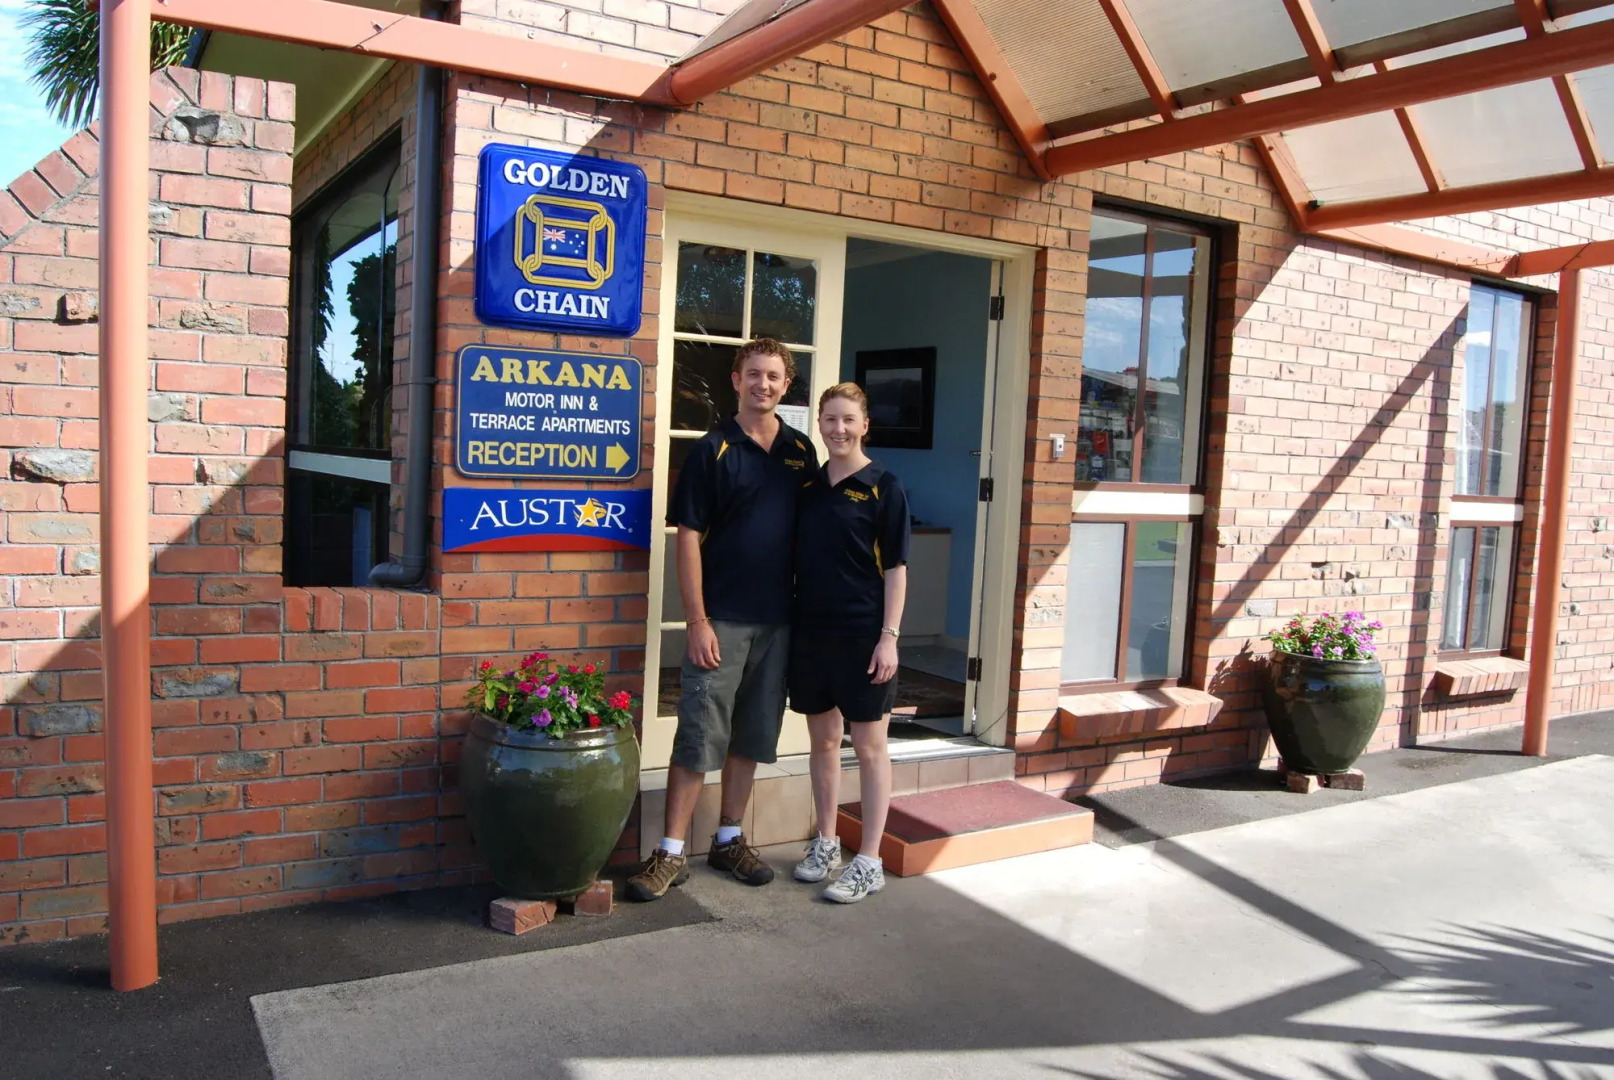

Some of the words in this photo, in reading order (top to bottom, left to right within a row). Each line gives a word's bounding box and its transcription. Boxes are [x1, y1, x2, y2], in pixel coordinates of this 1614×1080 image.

[503, 158, 630, 199] GOLDEN
[513, 287, 611, 319] CHAIN
[470, 355, 632, 391] ARKANA
[504, 391, 555, 409] MOTOR
[560, 394, 584, 411] INN
[588, 395, 599, 411] &
[470, 412, 536, 431] TERRACE
[541, 416, 631, 436] APARTMENTS
[467, 440, 597, 468] RECEPTION
